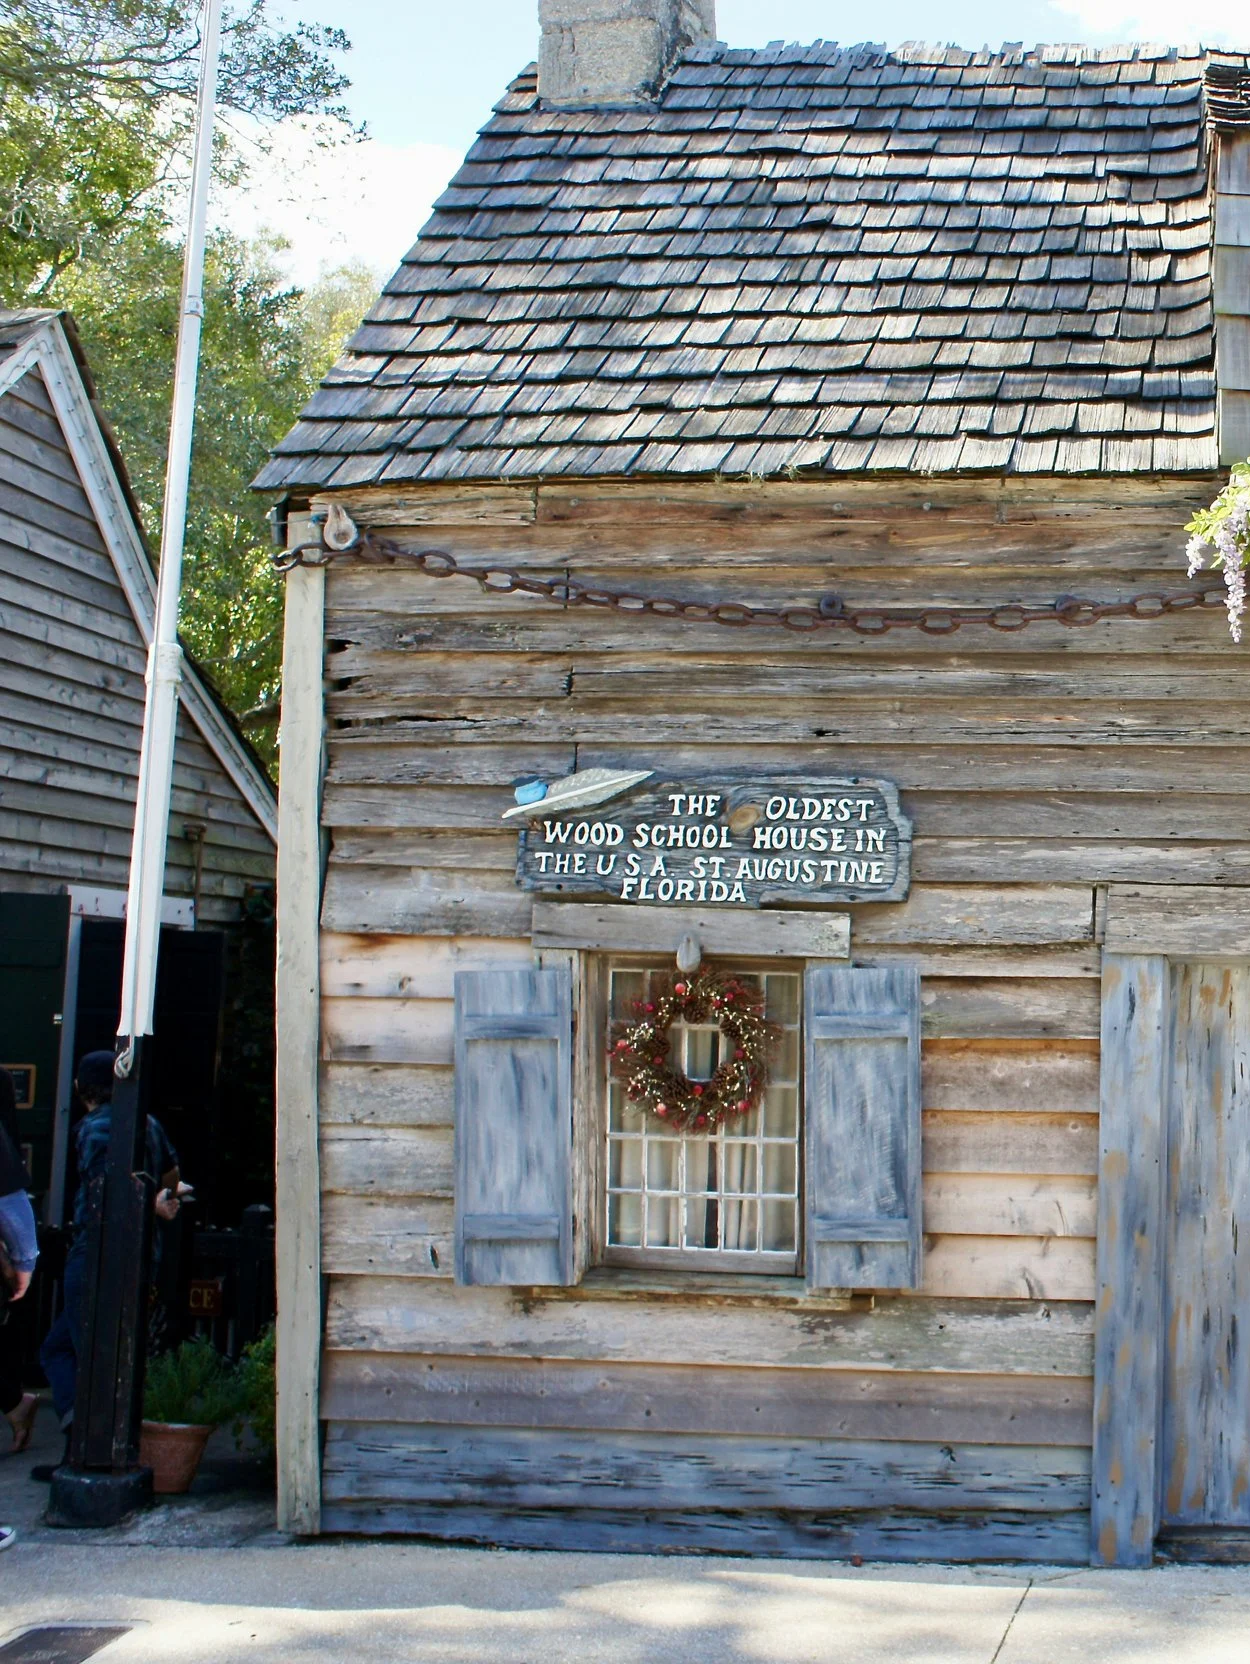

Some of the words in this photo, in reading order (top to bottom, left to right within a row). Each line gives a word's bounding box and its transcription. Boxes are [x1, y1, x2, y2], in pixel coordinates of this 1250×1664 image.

[668, 794, 721, 817] THE
[765, 796, 875, 822] OLDEST
[543, 821, 624, 846] WOOD
[632, 823, 732, 849] SCHOOL
[752, 826, 847, 852] HOUSE
[855, 828, 887, 853] IN
[534, 852, 587, 874] THE
[689, 856, 731, 879] ST.
[735, 857, 885, 884] AUGUSTINE
[620, 877, 747, 903] FLORIDA
